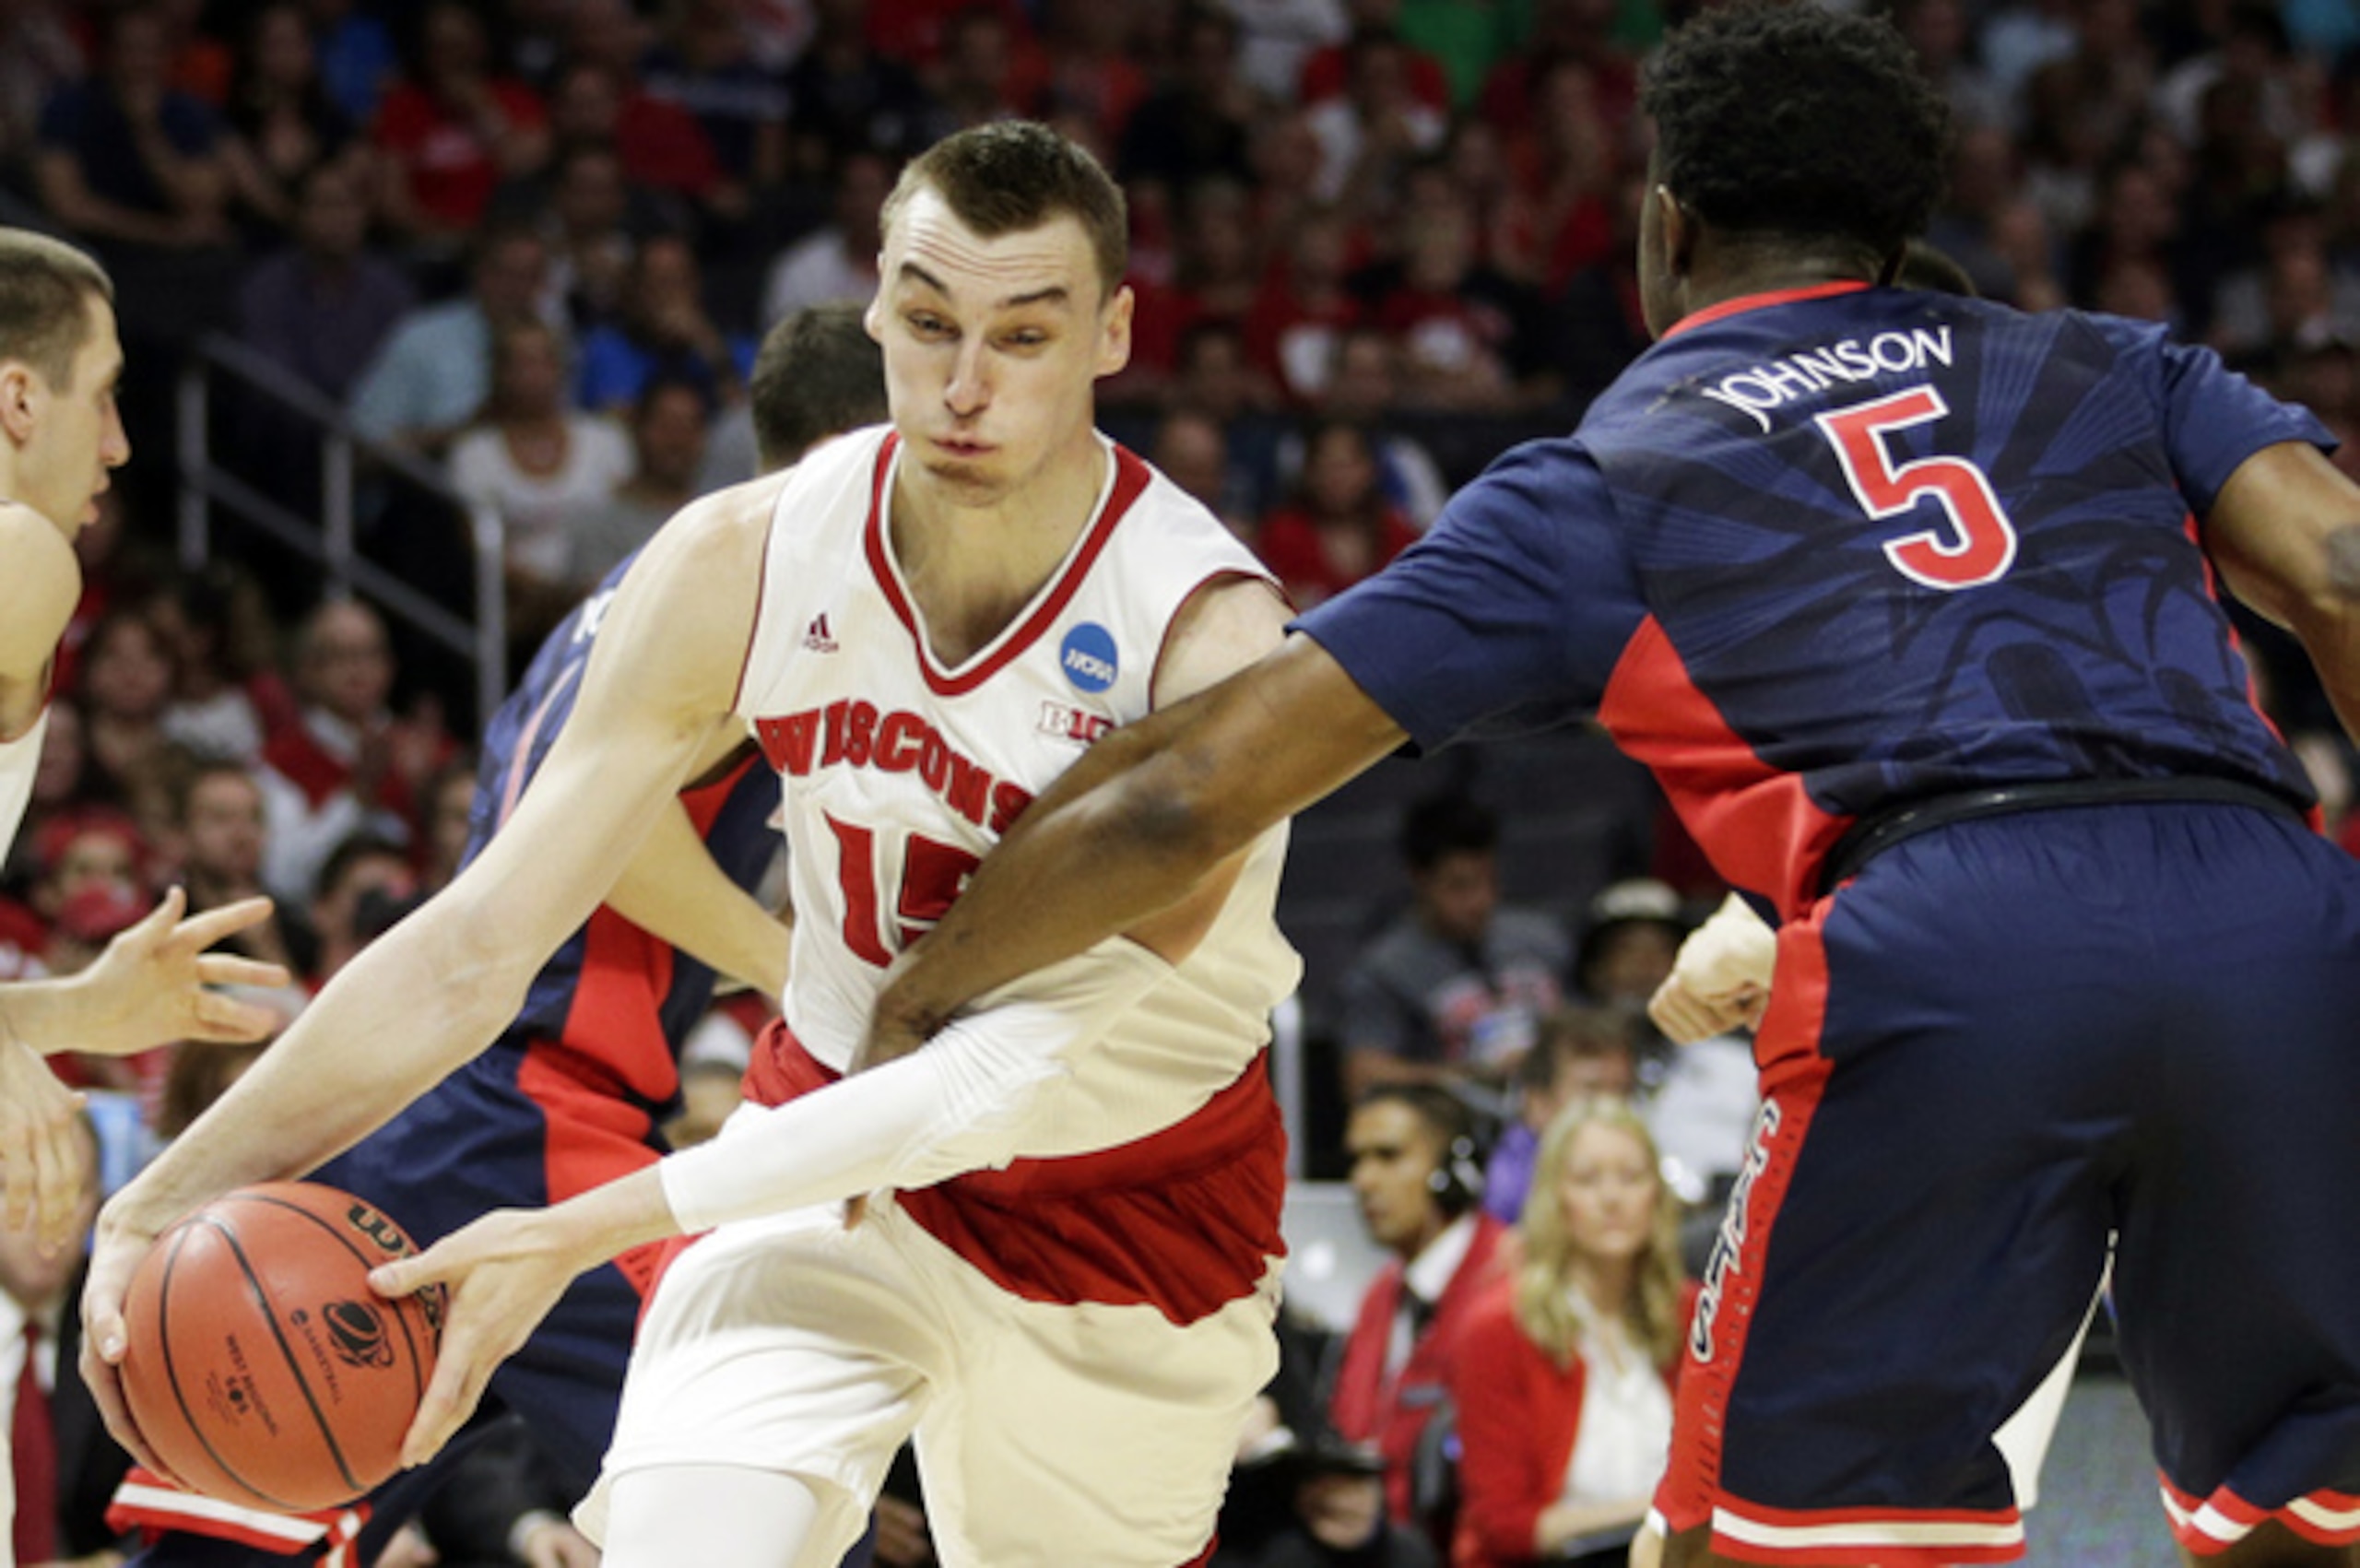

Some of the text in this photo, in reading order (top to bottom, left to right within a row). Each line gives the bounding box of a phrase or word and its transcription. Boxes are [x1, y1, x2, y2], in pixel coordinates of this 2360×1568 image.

[1702, 326, 1953, 432] JOHNSON
[1813, 383, 2017, 591] 5
[1064, 648, 1115, 684] NCAA
[754, 698, 1036, 834] WISCONS
